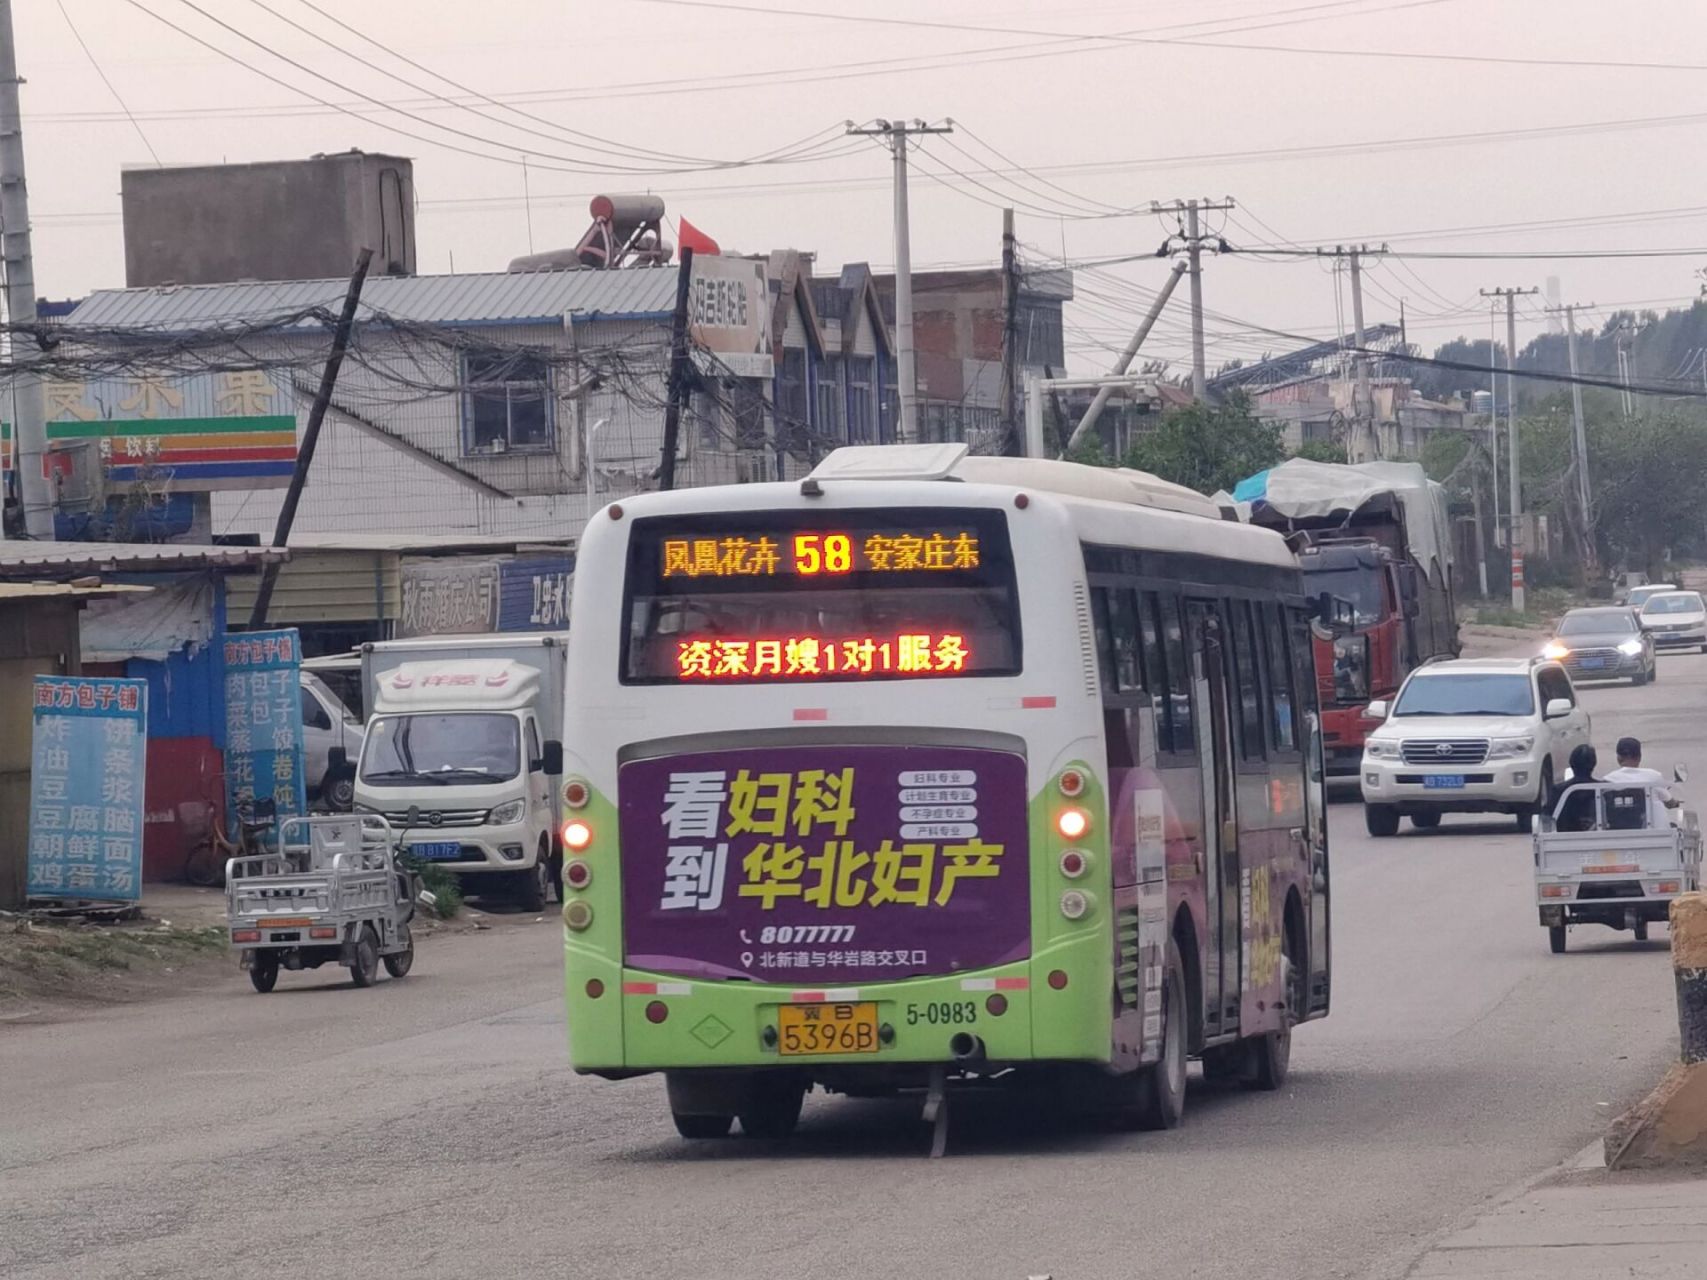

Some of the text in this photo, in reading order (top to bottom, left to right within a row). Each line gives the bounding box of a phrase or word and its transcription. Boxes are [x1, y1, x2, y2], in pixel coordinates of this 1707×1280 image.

[663, 532, 979, 576] 凤凰花卉 58 安家庄东
[678, 634, 969, 677] 资深月嫂1对1服务
[35, 682, 139, 710] 南方包子铺
[34, 803, 135, 833] 豆腐脑
[660, 767, 855, 839] 看妇科
[32, 833, 135, 863] 朝鲜面
[30, 862, 133, 892] 鸡蛋汤
[760, 925, 856, 944] 8077777
[759, 950, 927, 968] 北新道与华岩路交叉口
[907, 1002, 977, 1025] 5-0983
[785, 1022, 873, 1051] 5396B
